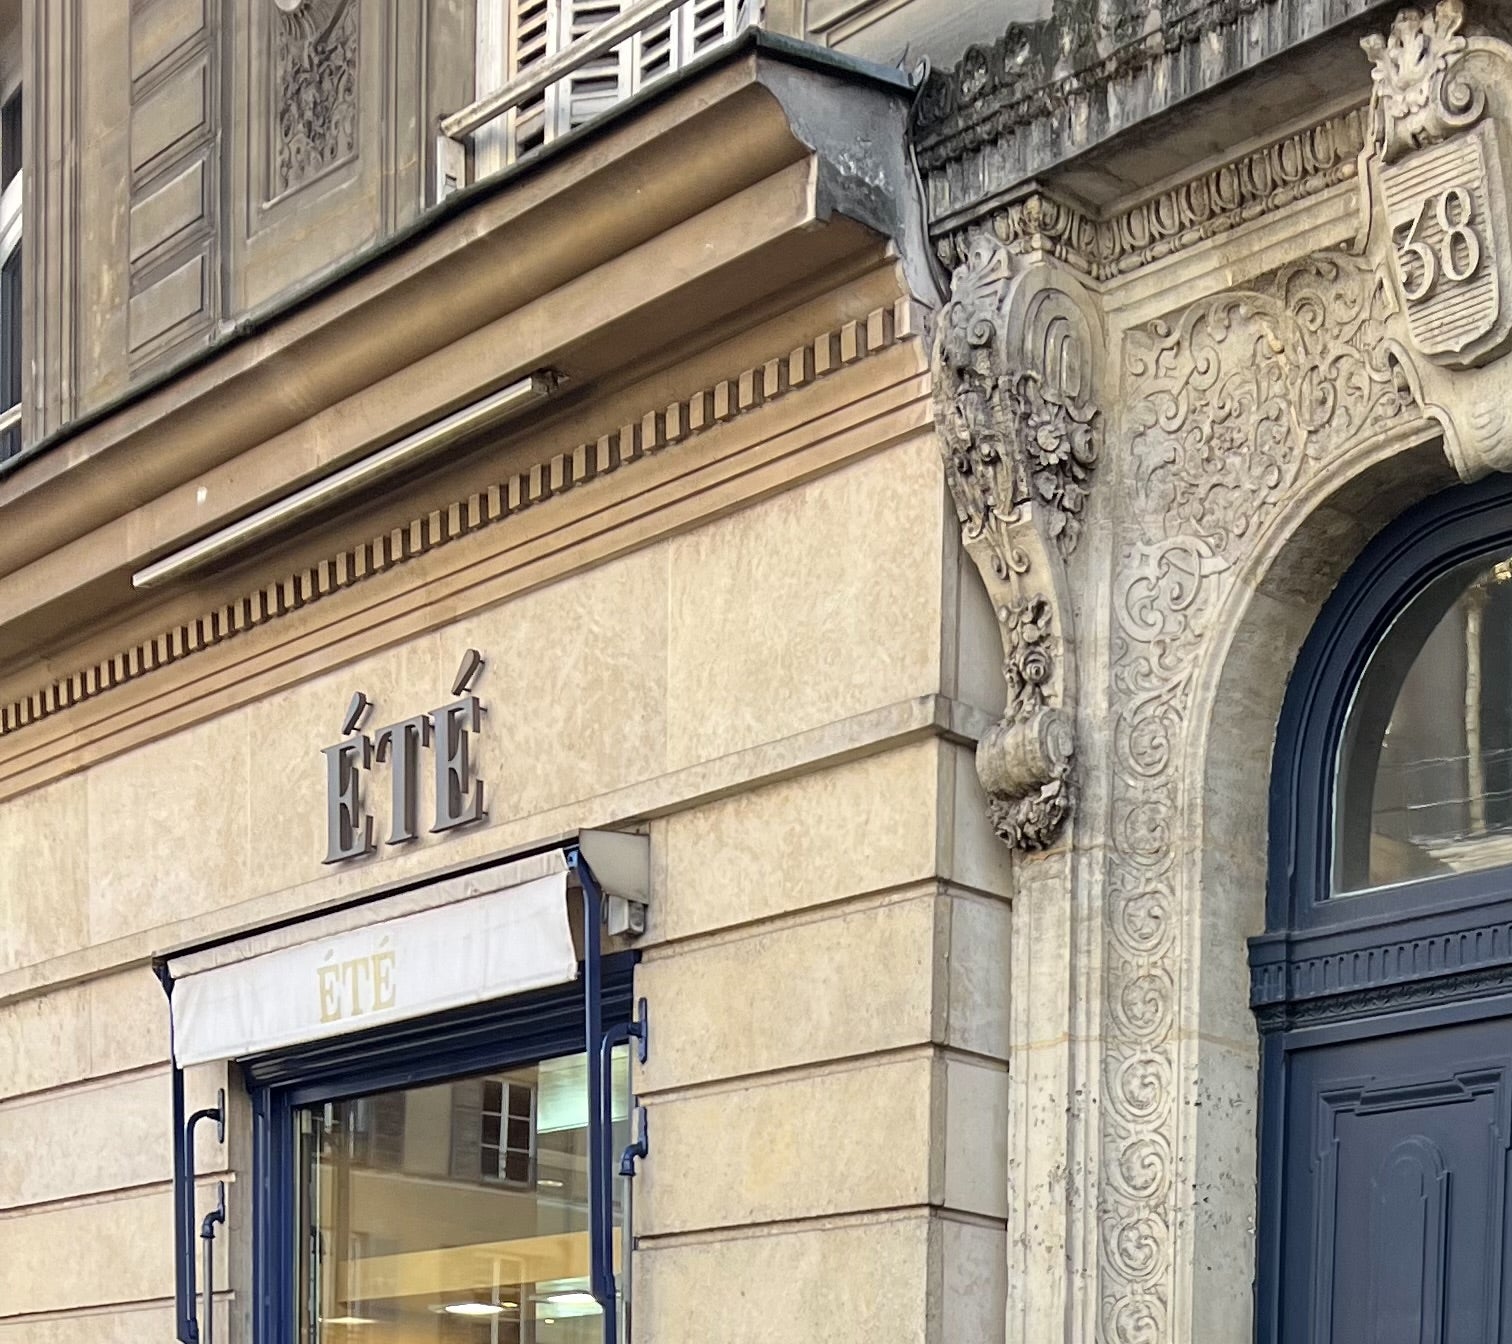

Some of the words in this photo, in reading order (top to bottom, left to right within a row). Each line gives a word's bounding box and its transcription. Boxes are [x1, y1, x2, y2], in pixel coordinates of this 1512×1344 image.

[1391, 186, 1480, 301] 38
[320, 648, 485, 865] ÉTÉ
[316, 935, 397, 1024] ÉTÉ
